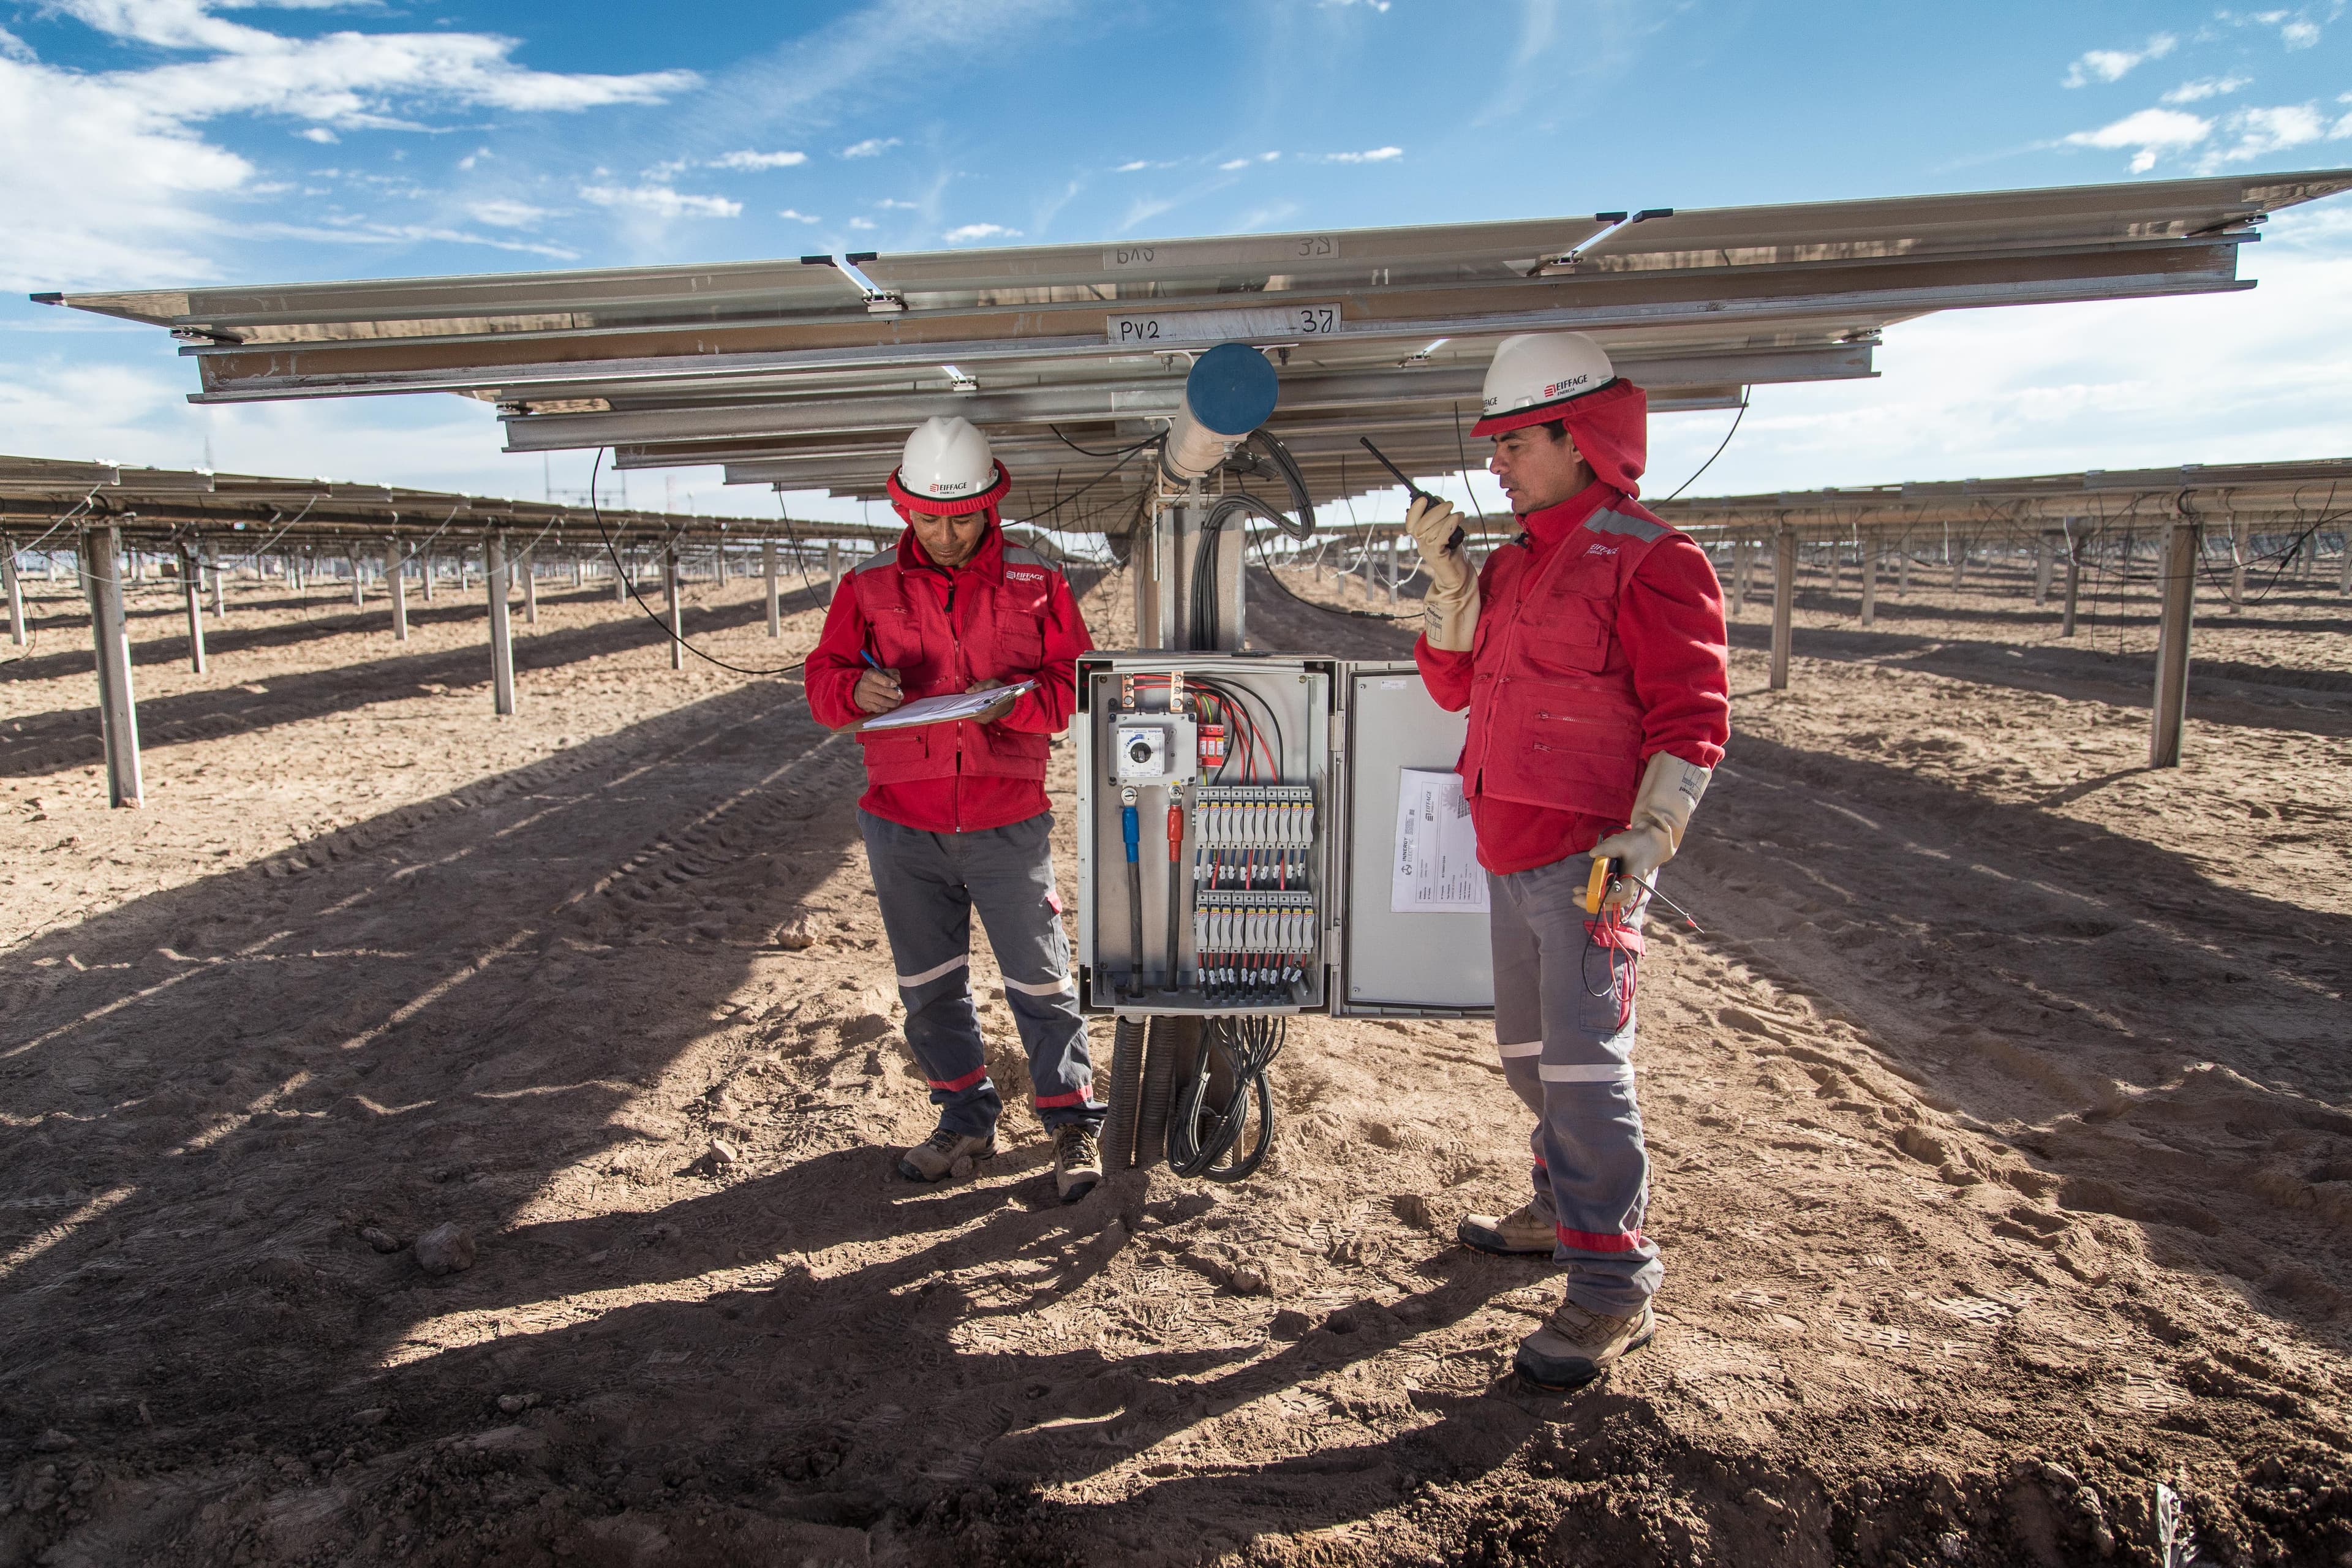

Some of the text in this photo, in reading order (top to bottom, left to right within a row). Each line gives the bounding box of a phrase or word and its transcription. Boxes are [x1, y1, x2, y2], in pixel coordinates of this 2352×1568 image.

[1120, 309, 1333, 341] PV2 37
[1556, 374, 1588, 391] EIFFAGE
[940, 481, 967, 491] EIFFAGE
[1017, 572, 1044, 581] EIFFAGE
